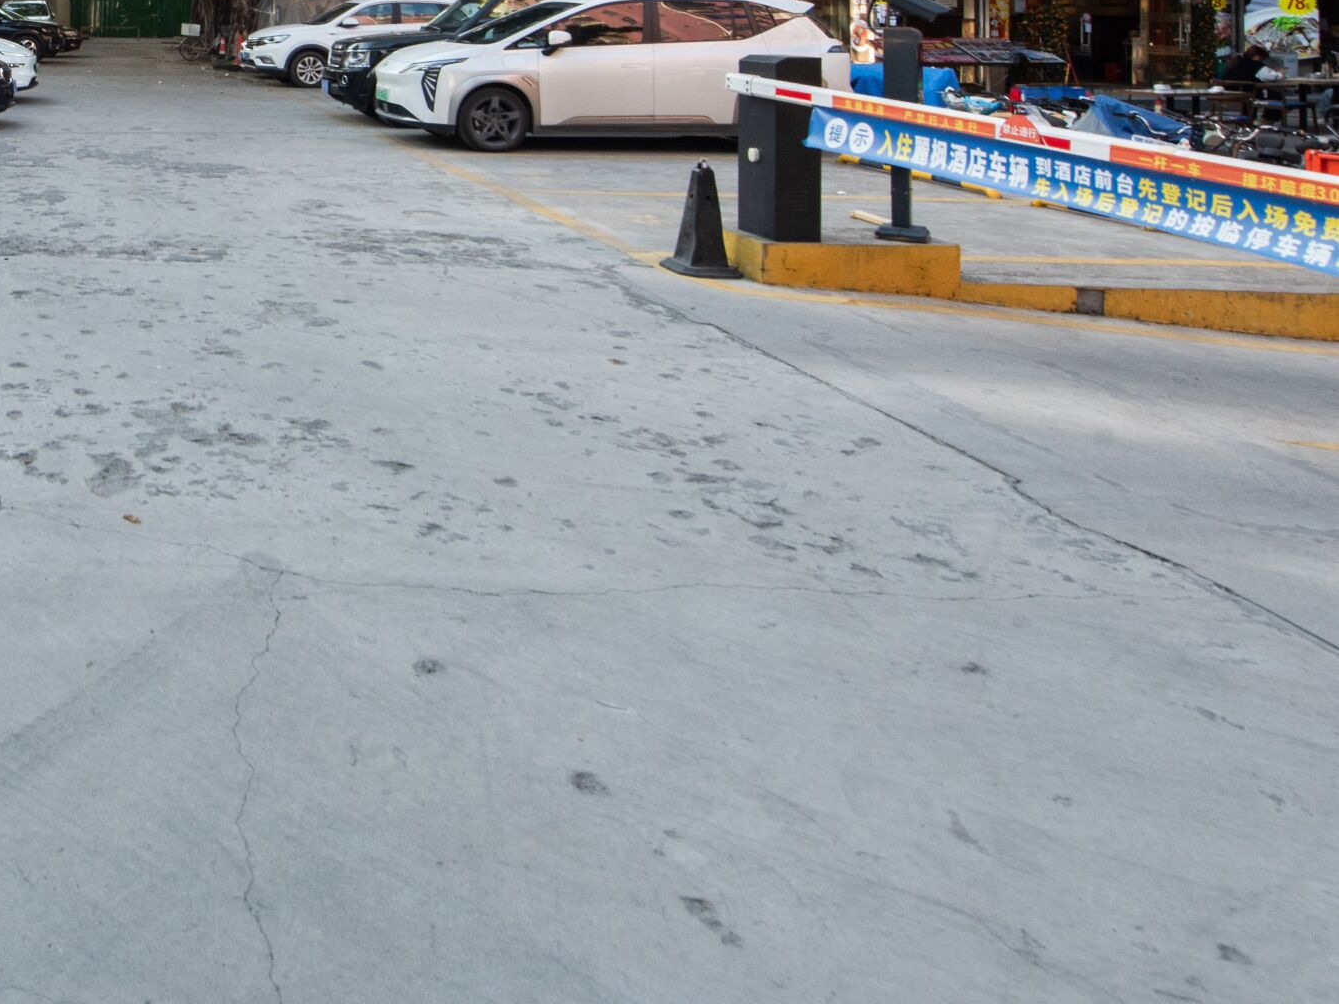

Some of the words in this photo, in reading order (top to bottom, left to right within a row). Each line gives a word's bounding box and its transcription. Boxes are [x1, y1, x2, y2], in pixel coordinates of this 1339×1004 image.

[903, 110, 978, 133] 严禁行人通行
[1001, 123, 1037, 139] 禁止通行
[828, 123, 870, 146] 提示
[1139, 155, 1202, 177] 一杆一车
[1032, 177, 1339, 272] 先入场后登记的按临停车辆
